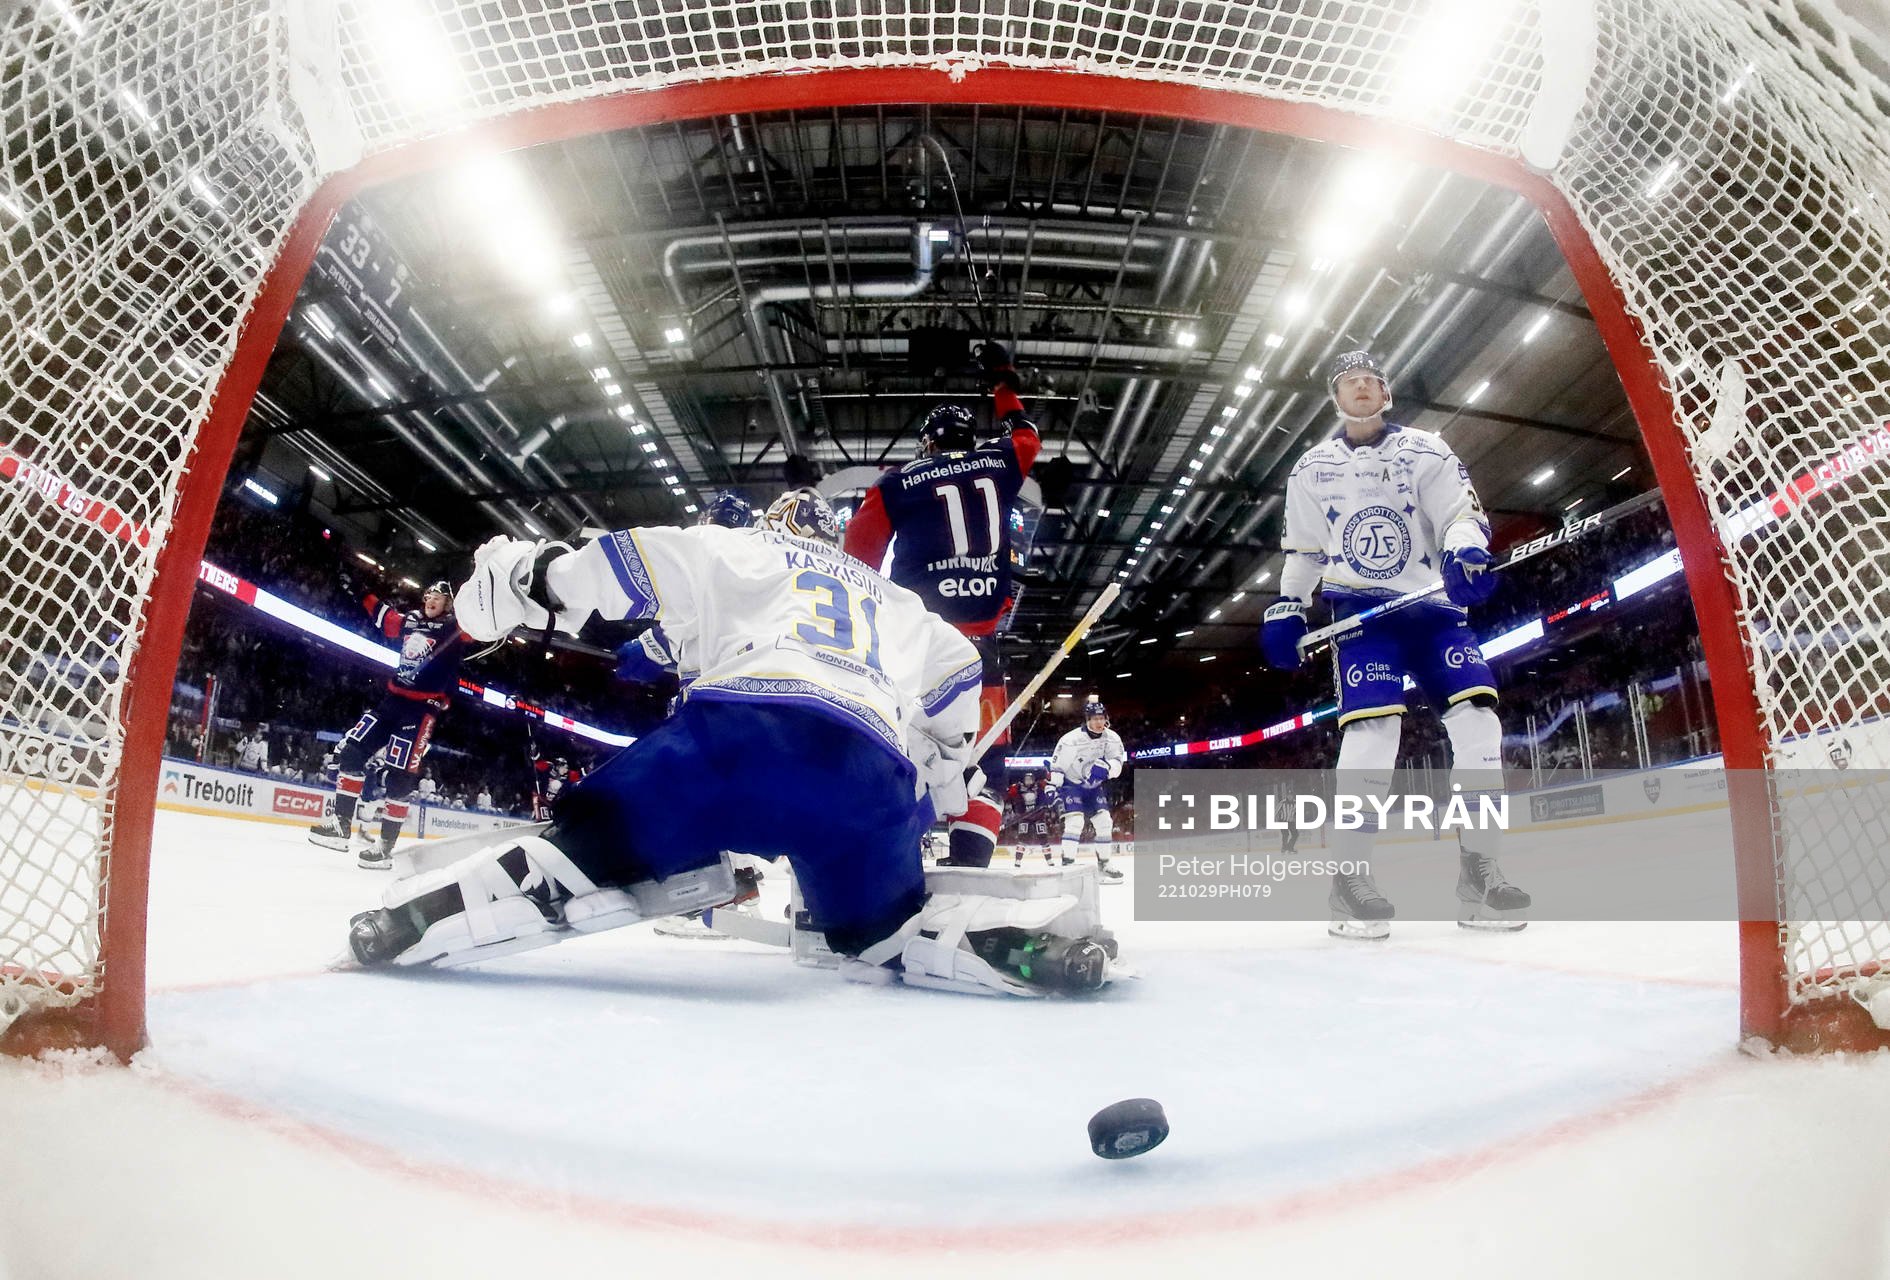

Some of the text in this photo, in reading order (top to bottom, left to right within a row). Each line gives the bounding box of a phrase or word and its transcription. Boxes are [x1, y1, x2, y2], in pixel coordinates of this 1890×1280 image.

[902, 456, 1006, 490] Handelsbanken
[1382, 467, 1391, 482] A
[936, 477, 1000, 557] 11
[200, 560, 238, 595] TNERS
[1359, 564, 1401, 579] ISHOCKEY
[1267, 604, 1304, 618] BAU
[792, 568, 883, 673] 31
[1366, 662, 1391, 672] Clas
[1366, 671, 1401, 684] Ohlson
[1147, 747, 1172, 756] VIDEO
[1209, 740, 1230, 751] CLUB
[183, 773, 254, 807] Trebolit
[276, 795, 321, 812] CCM
[431, 817, 479, 830] Handelsbanken
